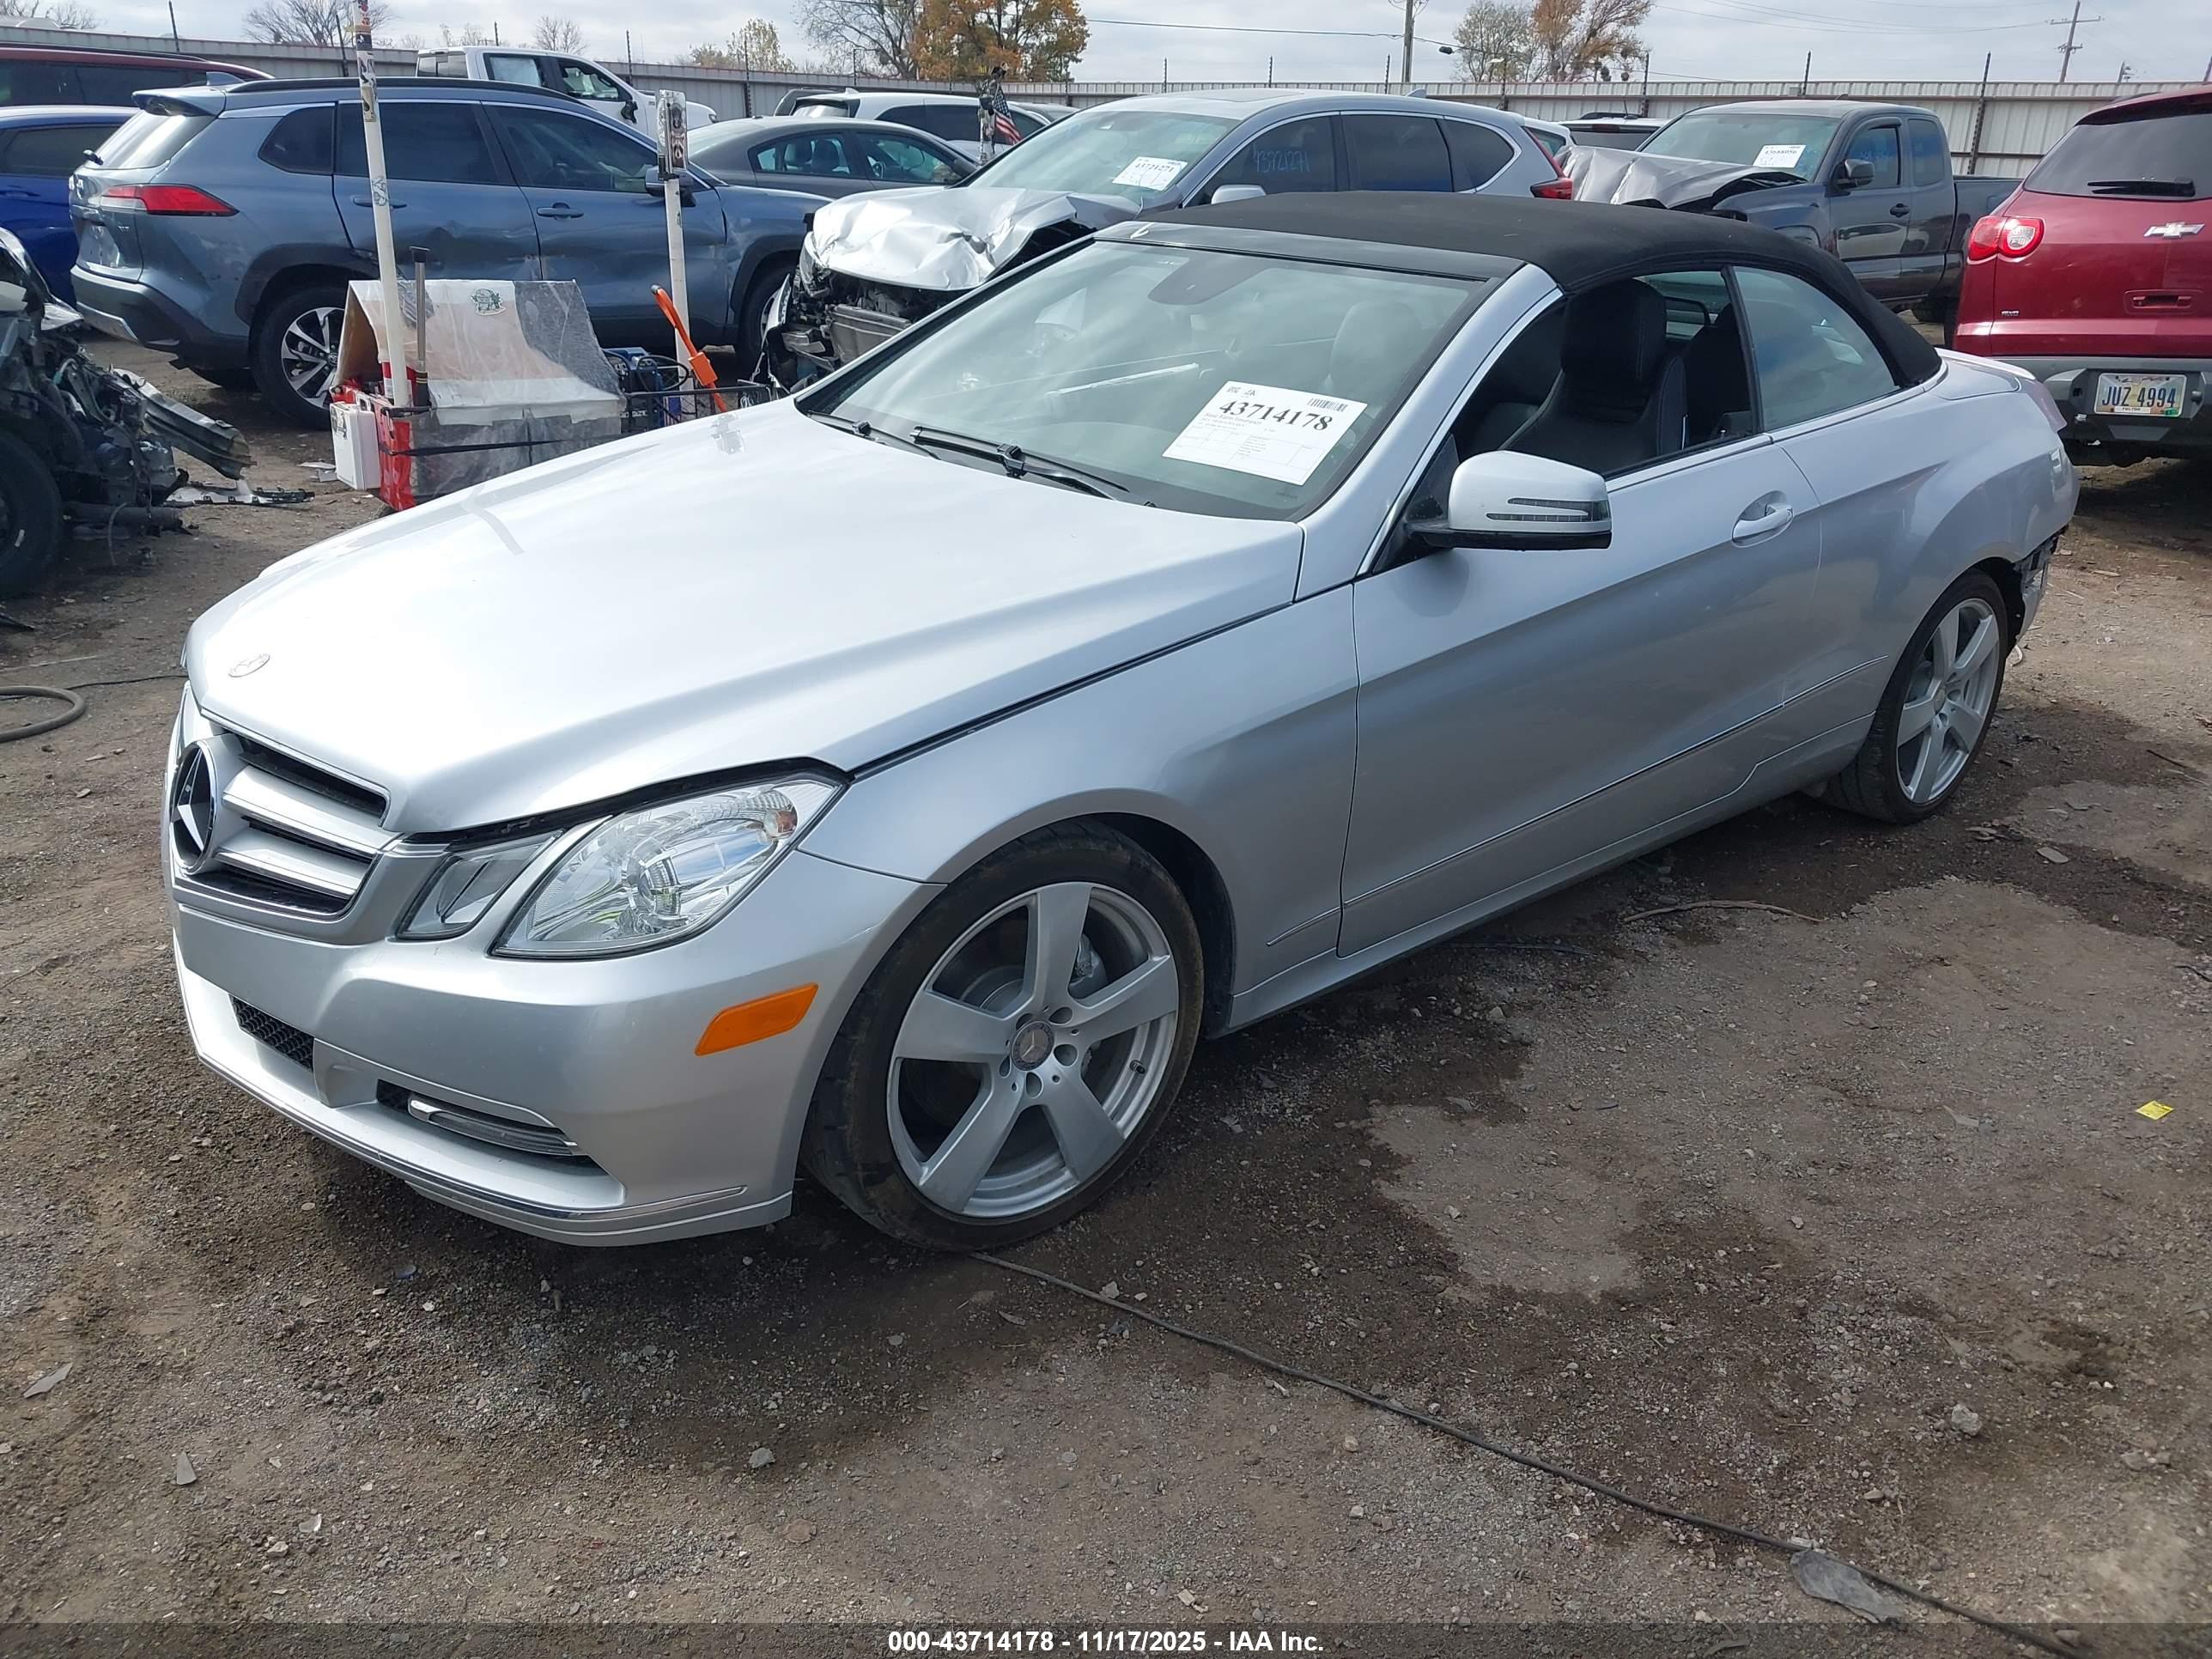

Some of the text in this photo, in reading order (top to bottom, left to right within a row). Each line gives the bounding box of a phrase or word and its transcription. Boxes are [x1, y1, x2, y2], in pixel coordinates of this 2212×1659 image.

[2102, 386, 2177, 408] JUZ 4994
[1219, 400, 1333, 430] 43714178
